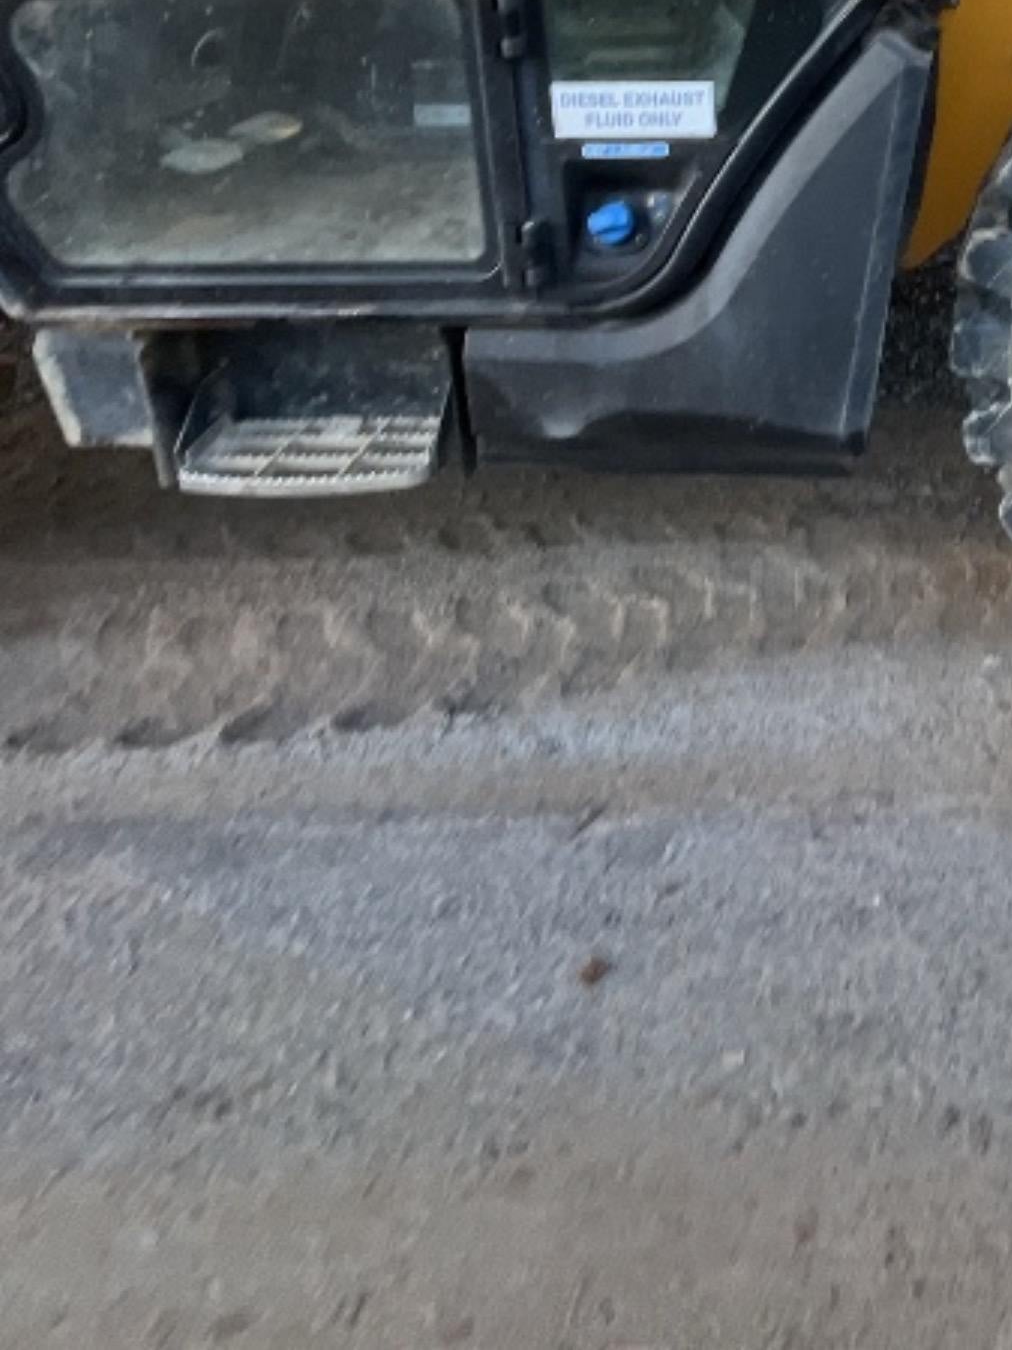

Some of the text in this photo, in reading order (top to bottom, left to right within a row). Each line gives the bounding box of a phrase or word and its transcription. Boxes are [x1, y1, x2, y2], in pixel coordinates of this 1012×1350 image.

[560, 90, 705, 108] DIESEL EXHAUST
[584, 110, 684, 128] FLUID ONLY
